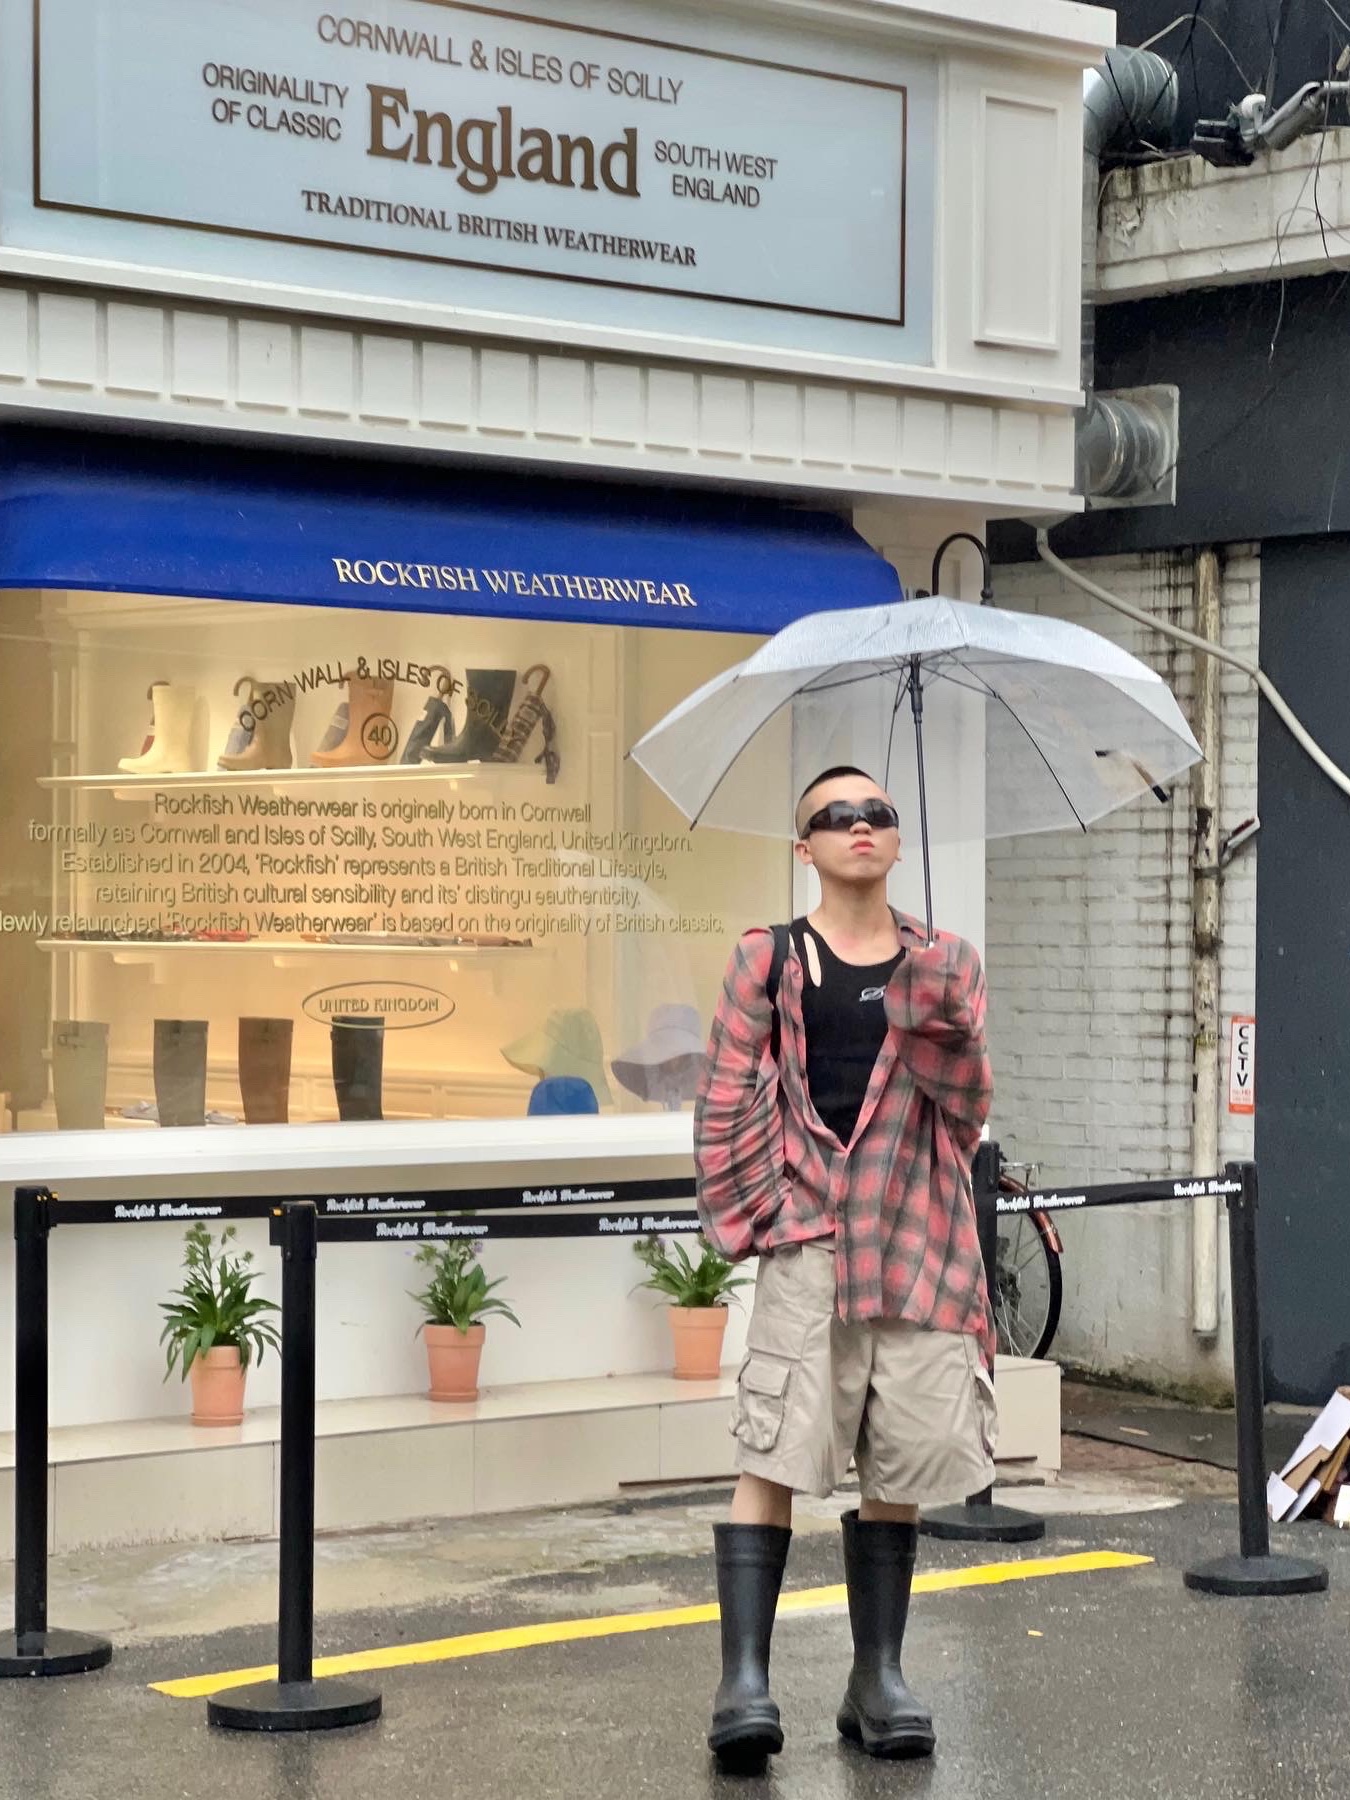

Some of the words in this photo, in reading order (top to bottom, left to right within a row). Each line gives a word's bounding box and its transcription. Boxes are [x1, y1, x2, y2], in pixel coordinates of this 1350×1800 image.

[317, 14, 462, 67] CORNWALL
[469, 39, 489, 71] &
[496, 47, 562, 84] ISLES
[569, 60, 601, 89] OF
[607, 67, 684, 105] SCILLY
[202, 62, 349, 109] ORIGINALILTY
[212, 98, 242, 124] OF
[246, 103, 342, 142] CLASSIC
[366, 83, 640, 197] England
[654, 139, 720, 172] SOUTH
[725, 152, 778, 180] WEST
[672, 174, 760, 208] ENGLAND
[301, 189, 452, 232] TRADITIONAL
[457, 213, 538, 245] BRITISH
[543, 225, 697, 267] WEATHERWEAR
[331, 558, 481, 592] ROCKFISH
[481, 569, 698, 607] WEATHERWEAR
[357, 656, 371, 680] &
[377, 658, 431, 688] ISLES
[436, 674, 463, 697] OF
[368, 724, 392, 747] 40
[154, 792, 233, 816] Rockfish
[240, 794, 358, 818] Weatherwear
[362, 798, 377, 818] is
[381, 799, 455, 824] originally
[502, 801, 516, 821] in
[520, 802, 591, 823] Cornwall
[29, 820, 108, 846] formally
[112, 827, 135, 844] as
[141, 823, 220, 845] Cornwall
[225, 825, 259, 846] and
[265, 825, 304, 846] Isles
[309, 826, 326, 846] of
[331, 826, 377, 851] Scilly,
[382, 826, 434, 847] South
[438, 828, 482, 849] West
[487, 829, 556, 854] England,
[562, 831, 614, 850] United
[62, 850, 173, 874] Established
[178, 853, 194, 873] in
[199, 853, 250, 876] 2004,
[344, 857, 436, 880] represents
[440, 861, 450, 877] a
[455, 857, 507, 878] British
[514, 858, 594, 878] Traditional
[96, 882, 176, 908] retaining
[182, 883, 238, 904] British
[244, 883, 307, 904] cultural
[311, 884, 397, 908] sensibility
[401, 884, 434, 904] and
[0, 910, 48, 936] ewly
[53, 912, 162, 932] relaunched
[382, 913, 396, 932] is
[401, 913, 453, 933] based
[458, 916, 479, 933] on
[484, 914, 511, 933] the
[515, 914, 592, 937] originality
[596, 914, 610, 933] of
[616, 914, 665, 933] British
[319, 998, 370, 1013] UNITED
[374, 997, 439, 1013] KINGDOM
[1236, 1025, 1249, 1087] CCTV
